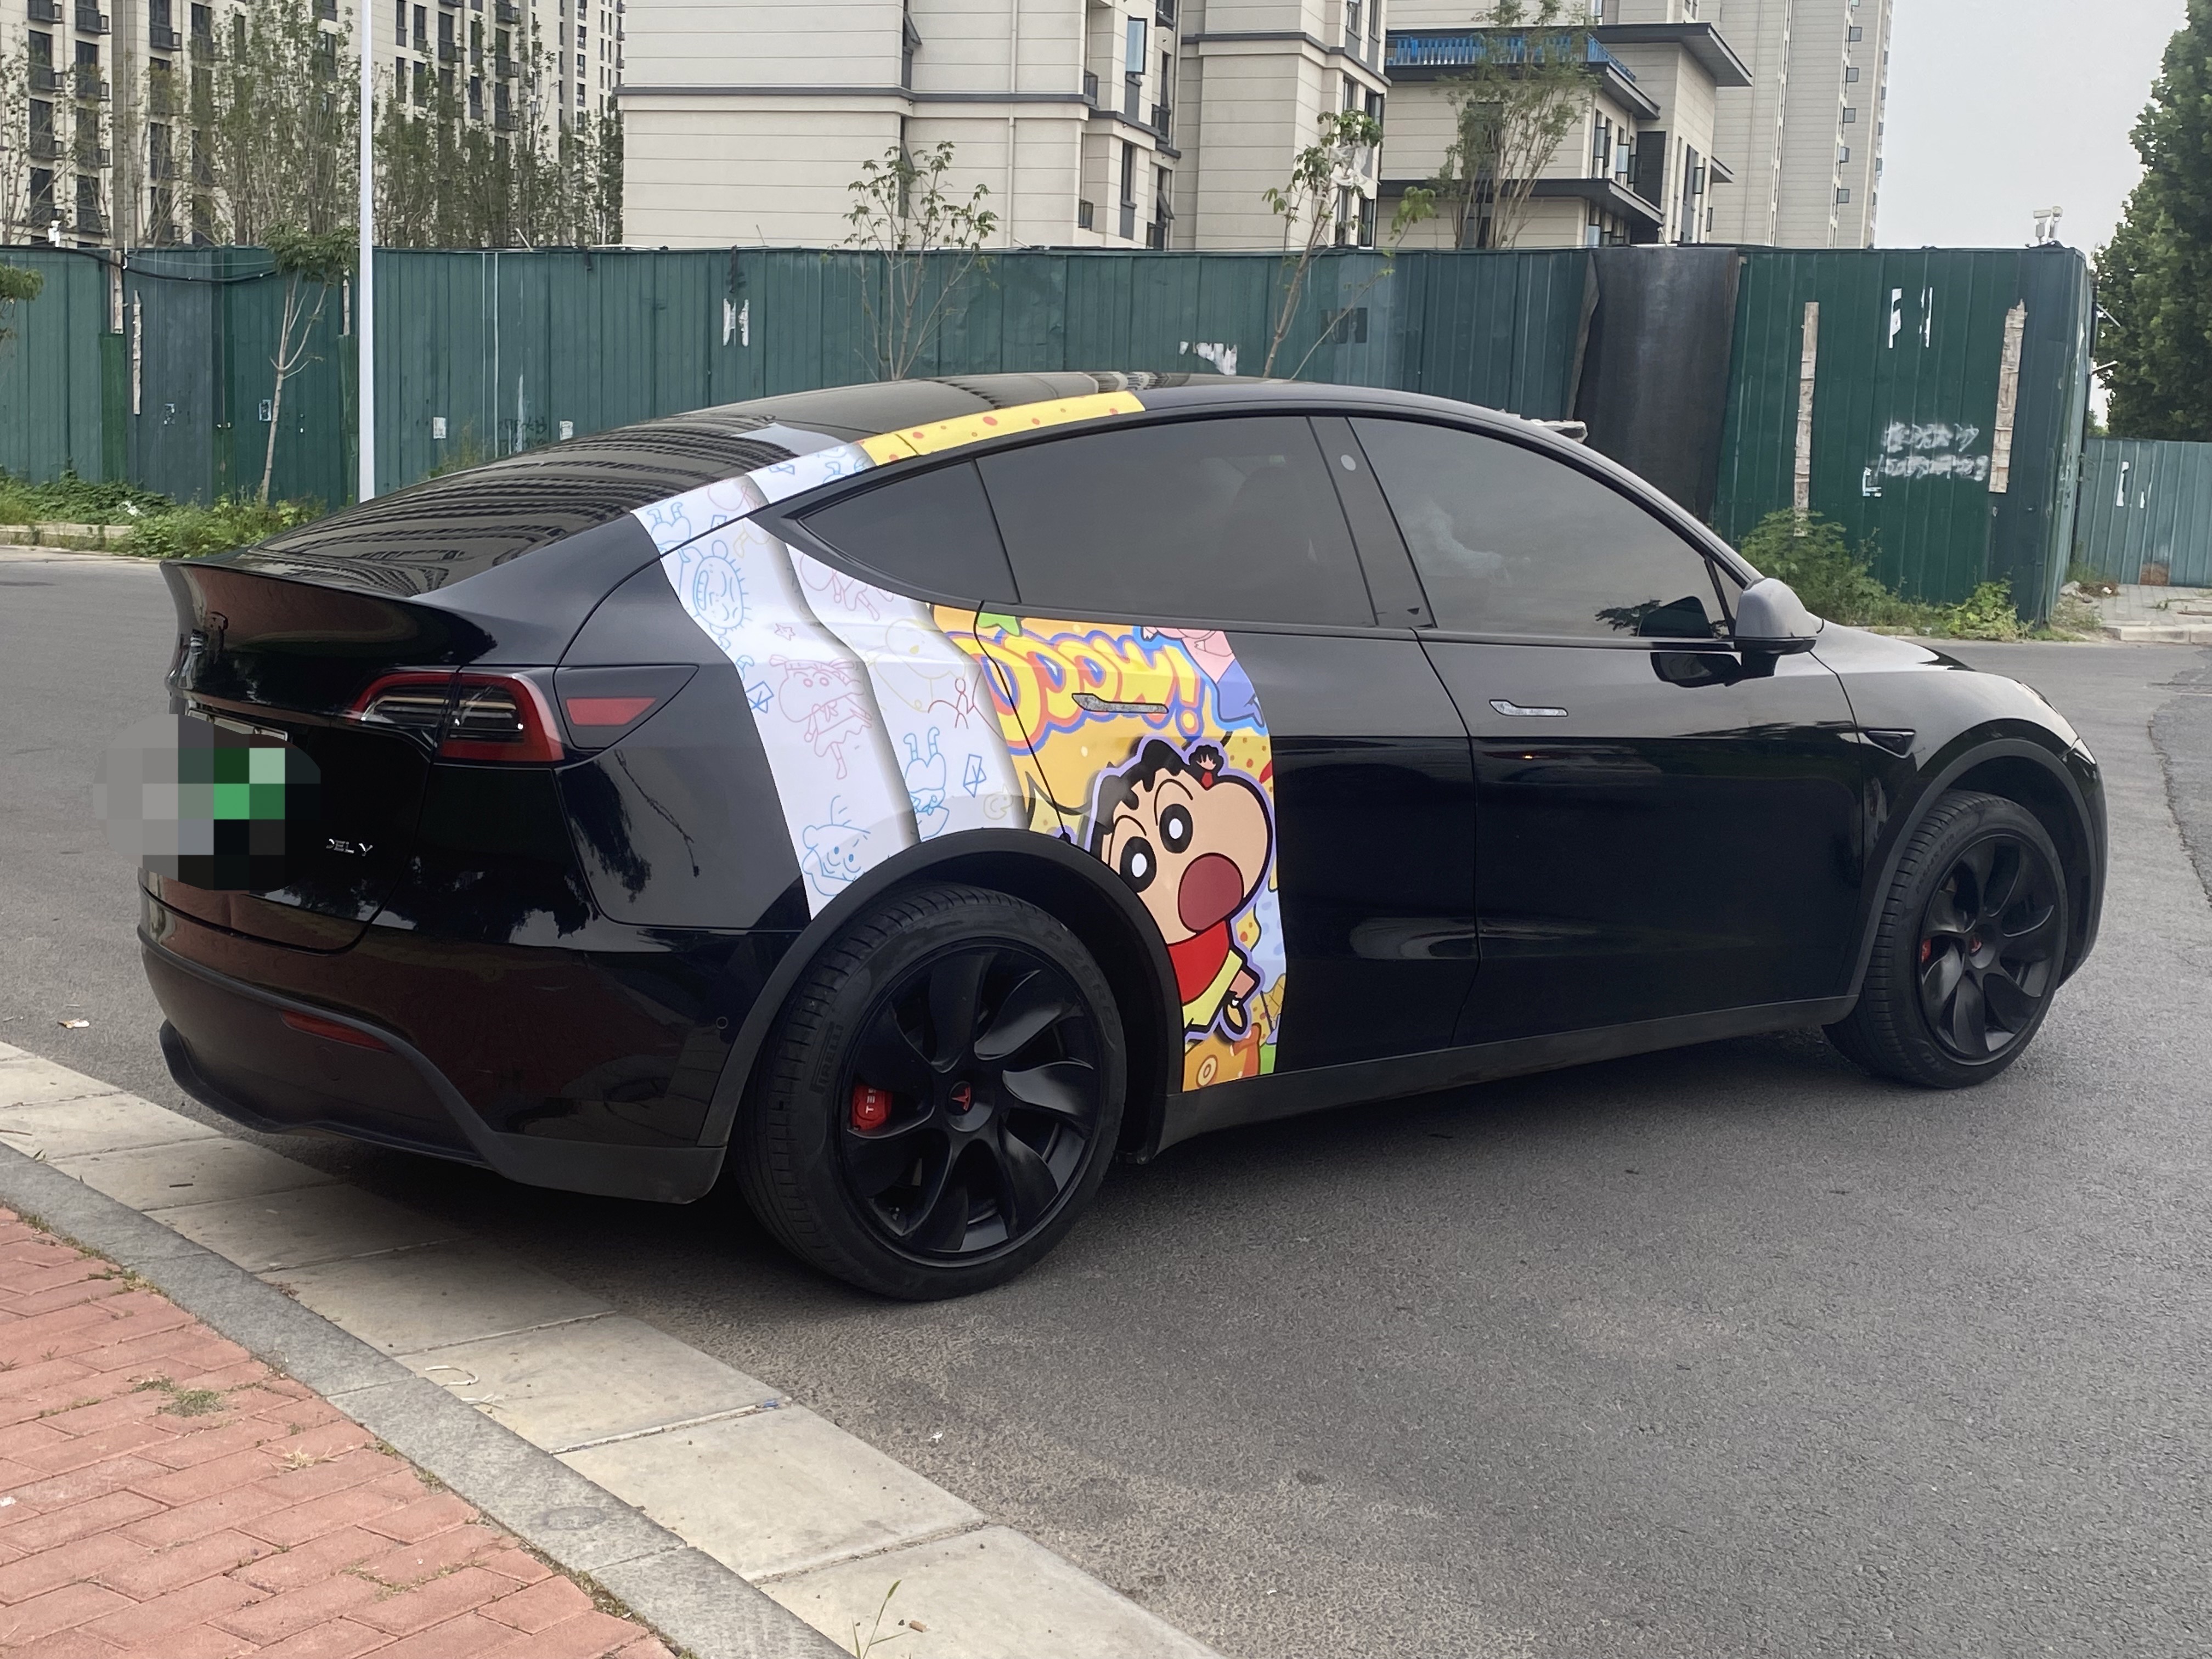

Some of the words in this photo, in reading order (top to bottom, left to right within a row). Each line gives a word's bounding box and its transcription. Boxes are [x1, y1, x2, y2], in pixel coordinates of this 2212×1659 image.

[326, 838, 354, 854] DEL
[358, 843, 373, 856] Y
[809, 1022, 844, 1095] PIRELLI
[865, 1087, 876, 1114] TES
